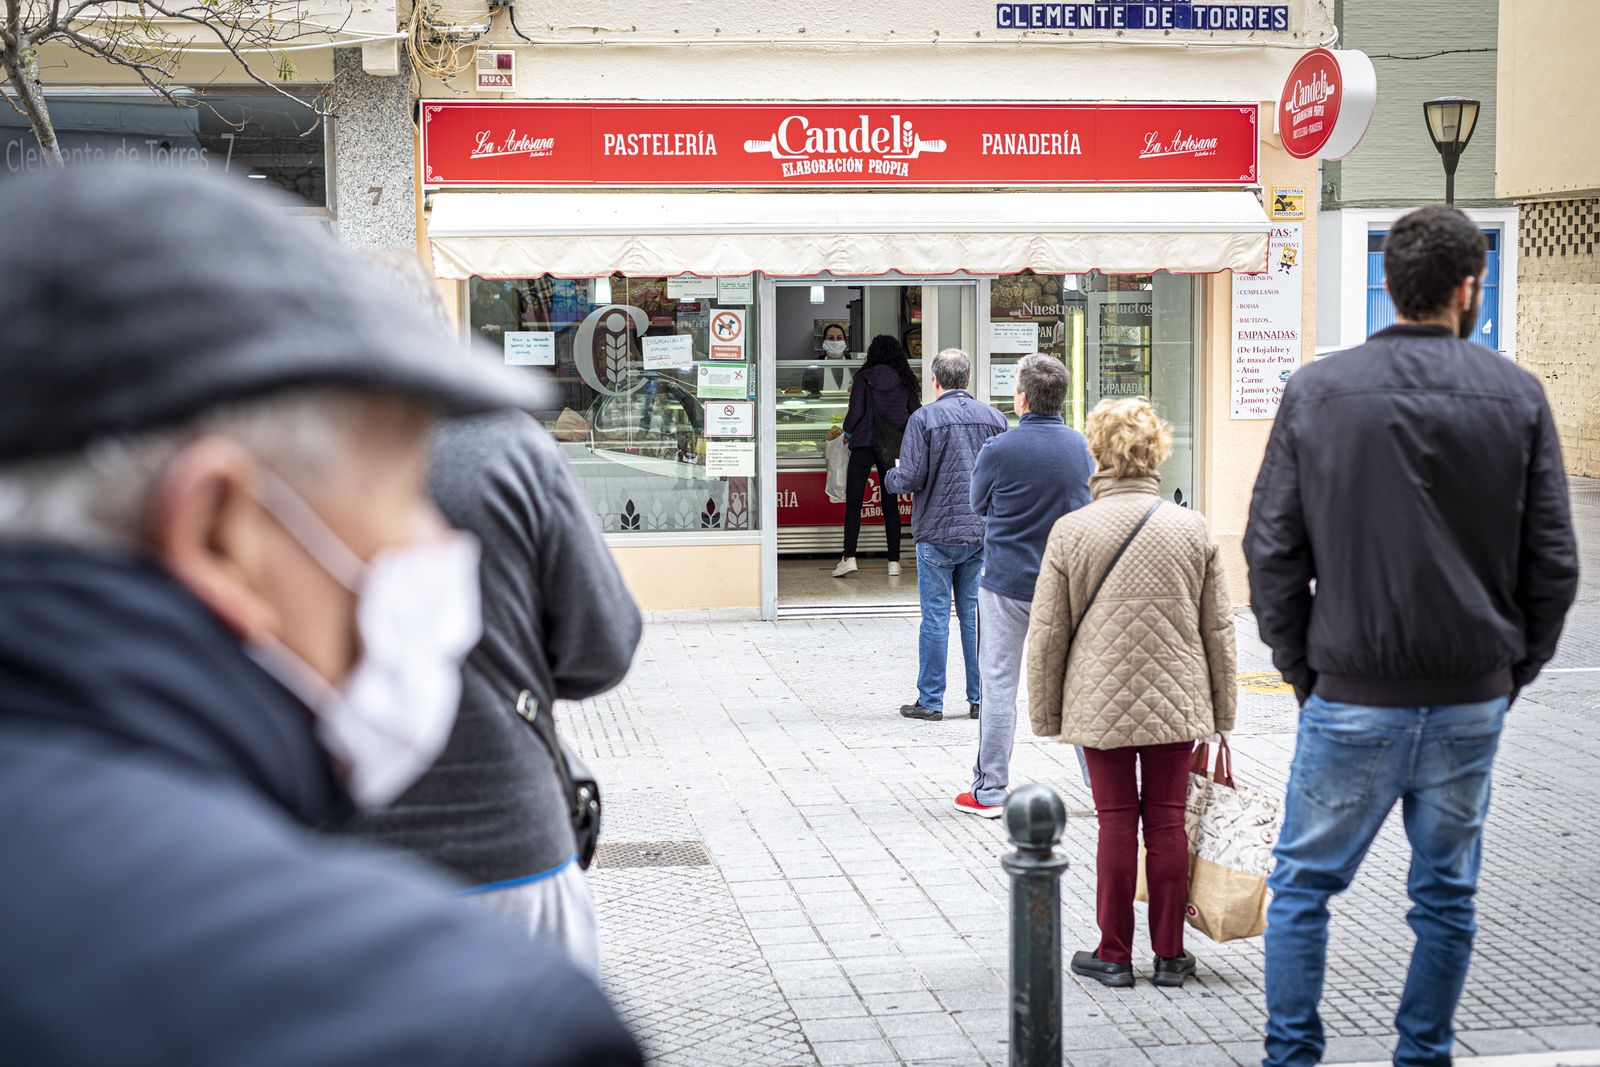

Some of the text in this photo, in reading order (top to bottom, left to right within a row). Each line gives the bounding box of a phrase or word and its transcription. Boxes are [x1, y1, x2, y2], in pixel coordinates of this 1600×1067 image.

[998, 6, 1287, 28] CLEMENTE DE TORRES
[481, 75, 509, 84] RUCA
[472, 129, 555, 154] La Artesana
[603, 130, 718, 156] PASTELERÍA
[982, 130, 1082, 155] PANADERÍA
[1140, 129, 1218, 154] La Artesana
[6, 133, 235, 173] Cleente de Torres 7
[781, 157, 909, 177] ELABORACIÓN PROPIA
[367, 185, 383, 206] 7
[1270, 228, 1292, 237] TAS:
[1022, 302, 1153, 316] Nuestros roductos
[1238, 330, 1298, 340] EMPANADAS:
[1237, 346, 1291, 355] (De Hojaldre y
[1278, 356, 1295, 364] Pan)
[1241, 366, 1260, 374] Atún
[1241, 376, 1264, 384] Carne
[1239, 386, 1265, 396] Jamón
[1271, 386, 1285, 394] Qu
[1239, 396, 1265, 406] Jamón
[1249, 406, 1268, 414] tiles
